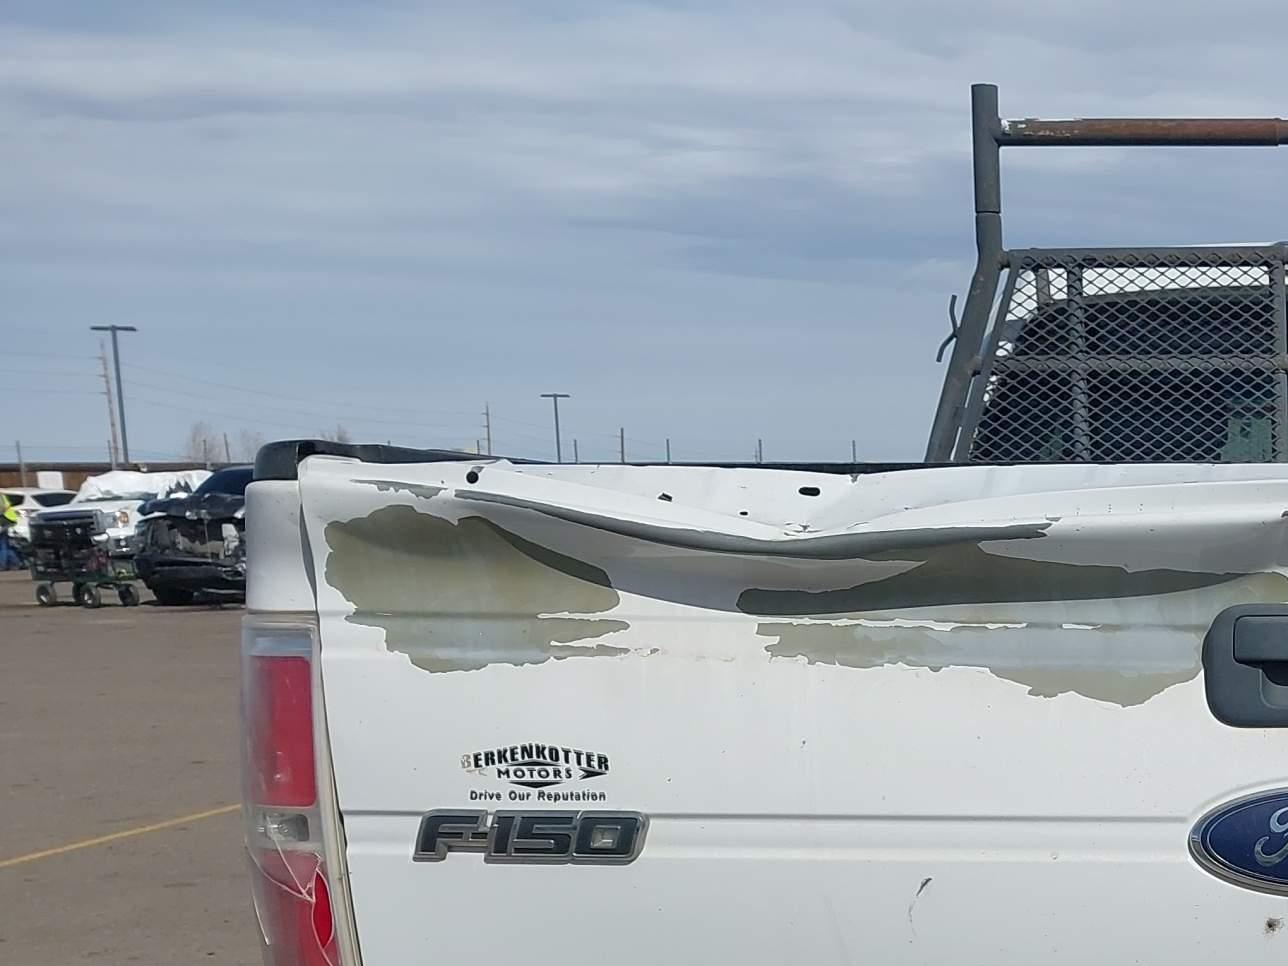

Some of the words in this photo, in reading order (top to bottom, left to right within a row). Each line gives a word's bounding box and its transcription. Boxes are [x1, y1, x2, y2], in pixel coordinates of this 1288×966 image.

[461, 743, 610, 772] BERKENKOTTER
[497, 767, 573, 779] MOTORS
[470, 790, 502, 801] Drive
[508, 790, 532, 801] Our
[537, 789, 606, 804] Reputation
[412, 809, 650, 865] F-150
